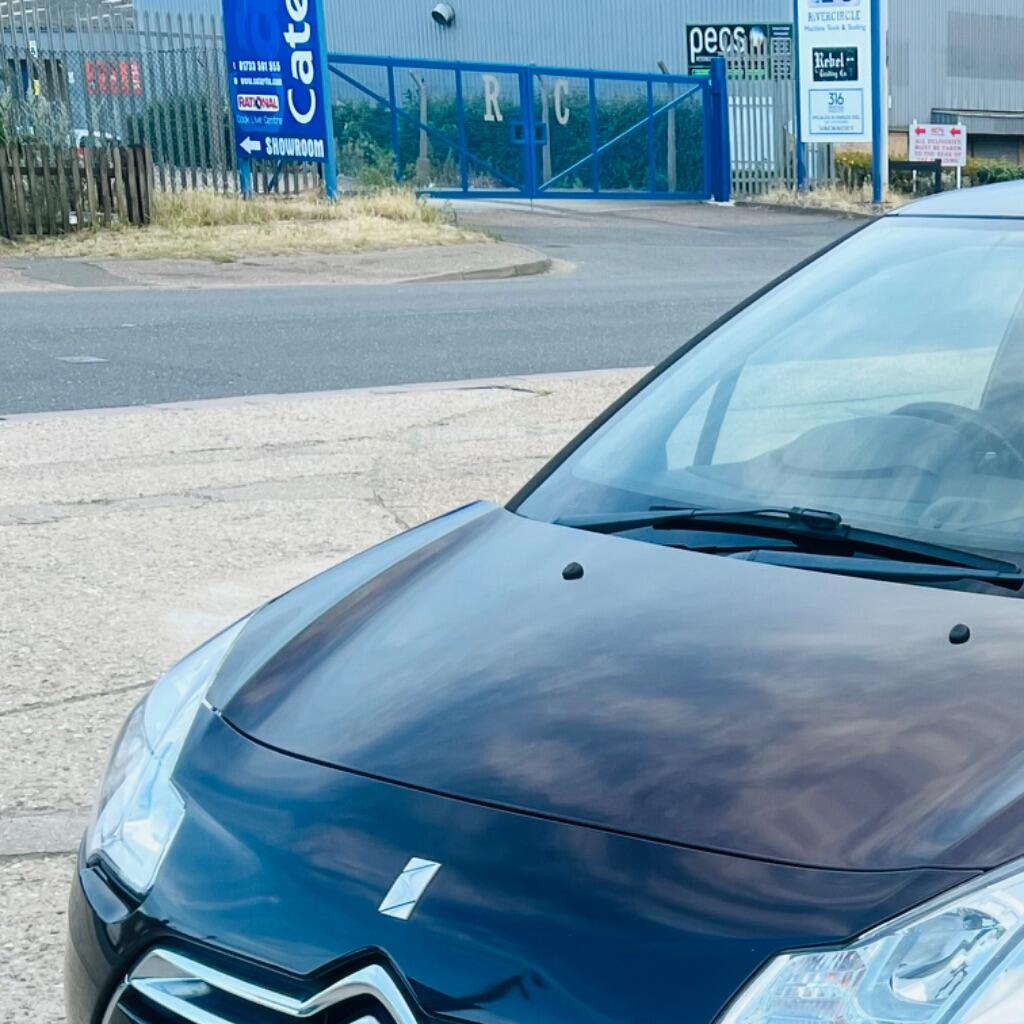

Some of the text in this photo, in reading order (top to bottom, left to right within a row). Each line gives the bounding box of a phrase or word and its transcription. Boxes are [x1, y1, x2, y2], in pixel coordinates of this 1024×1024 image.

[690, 26, 745, 63] pecs
[813, 51, 844, 69] Rebel
[239, 96, 278, 109] RATIONAL
[483, 75, 570, 125] R C
[828, 92, 844, 105] 316
[265, 136, 325, 158] SHOWROOM
